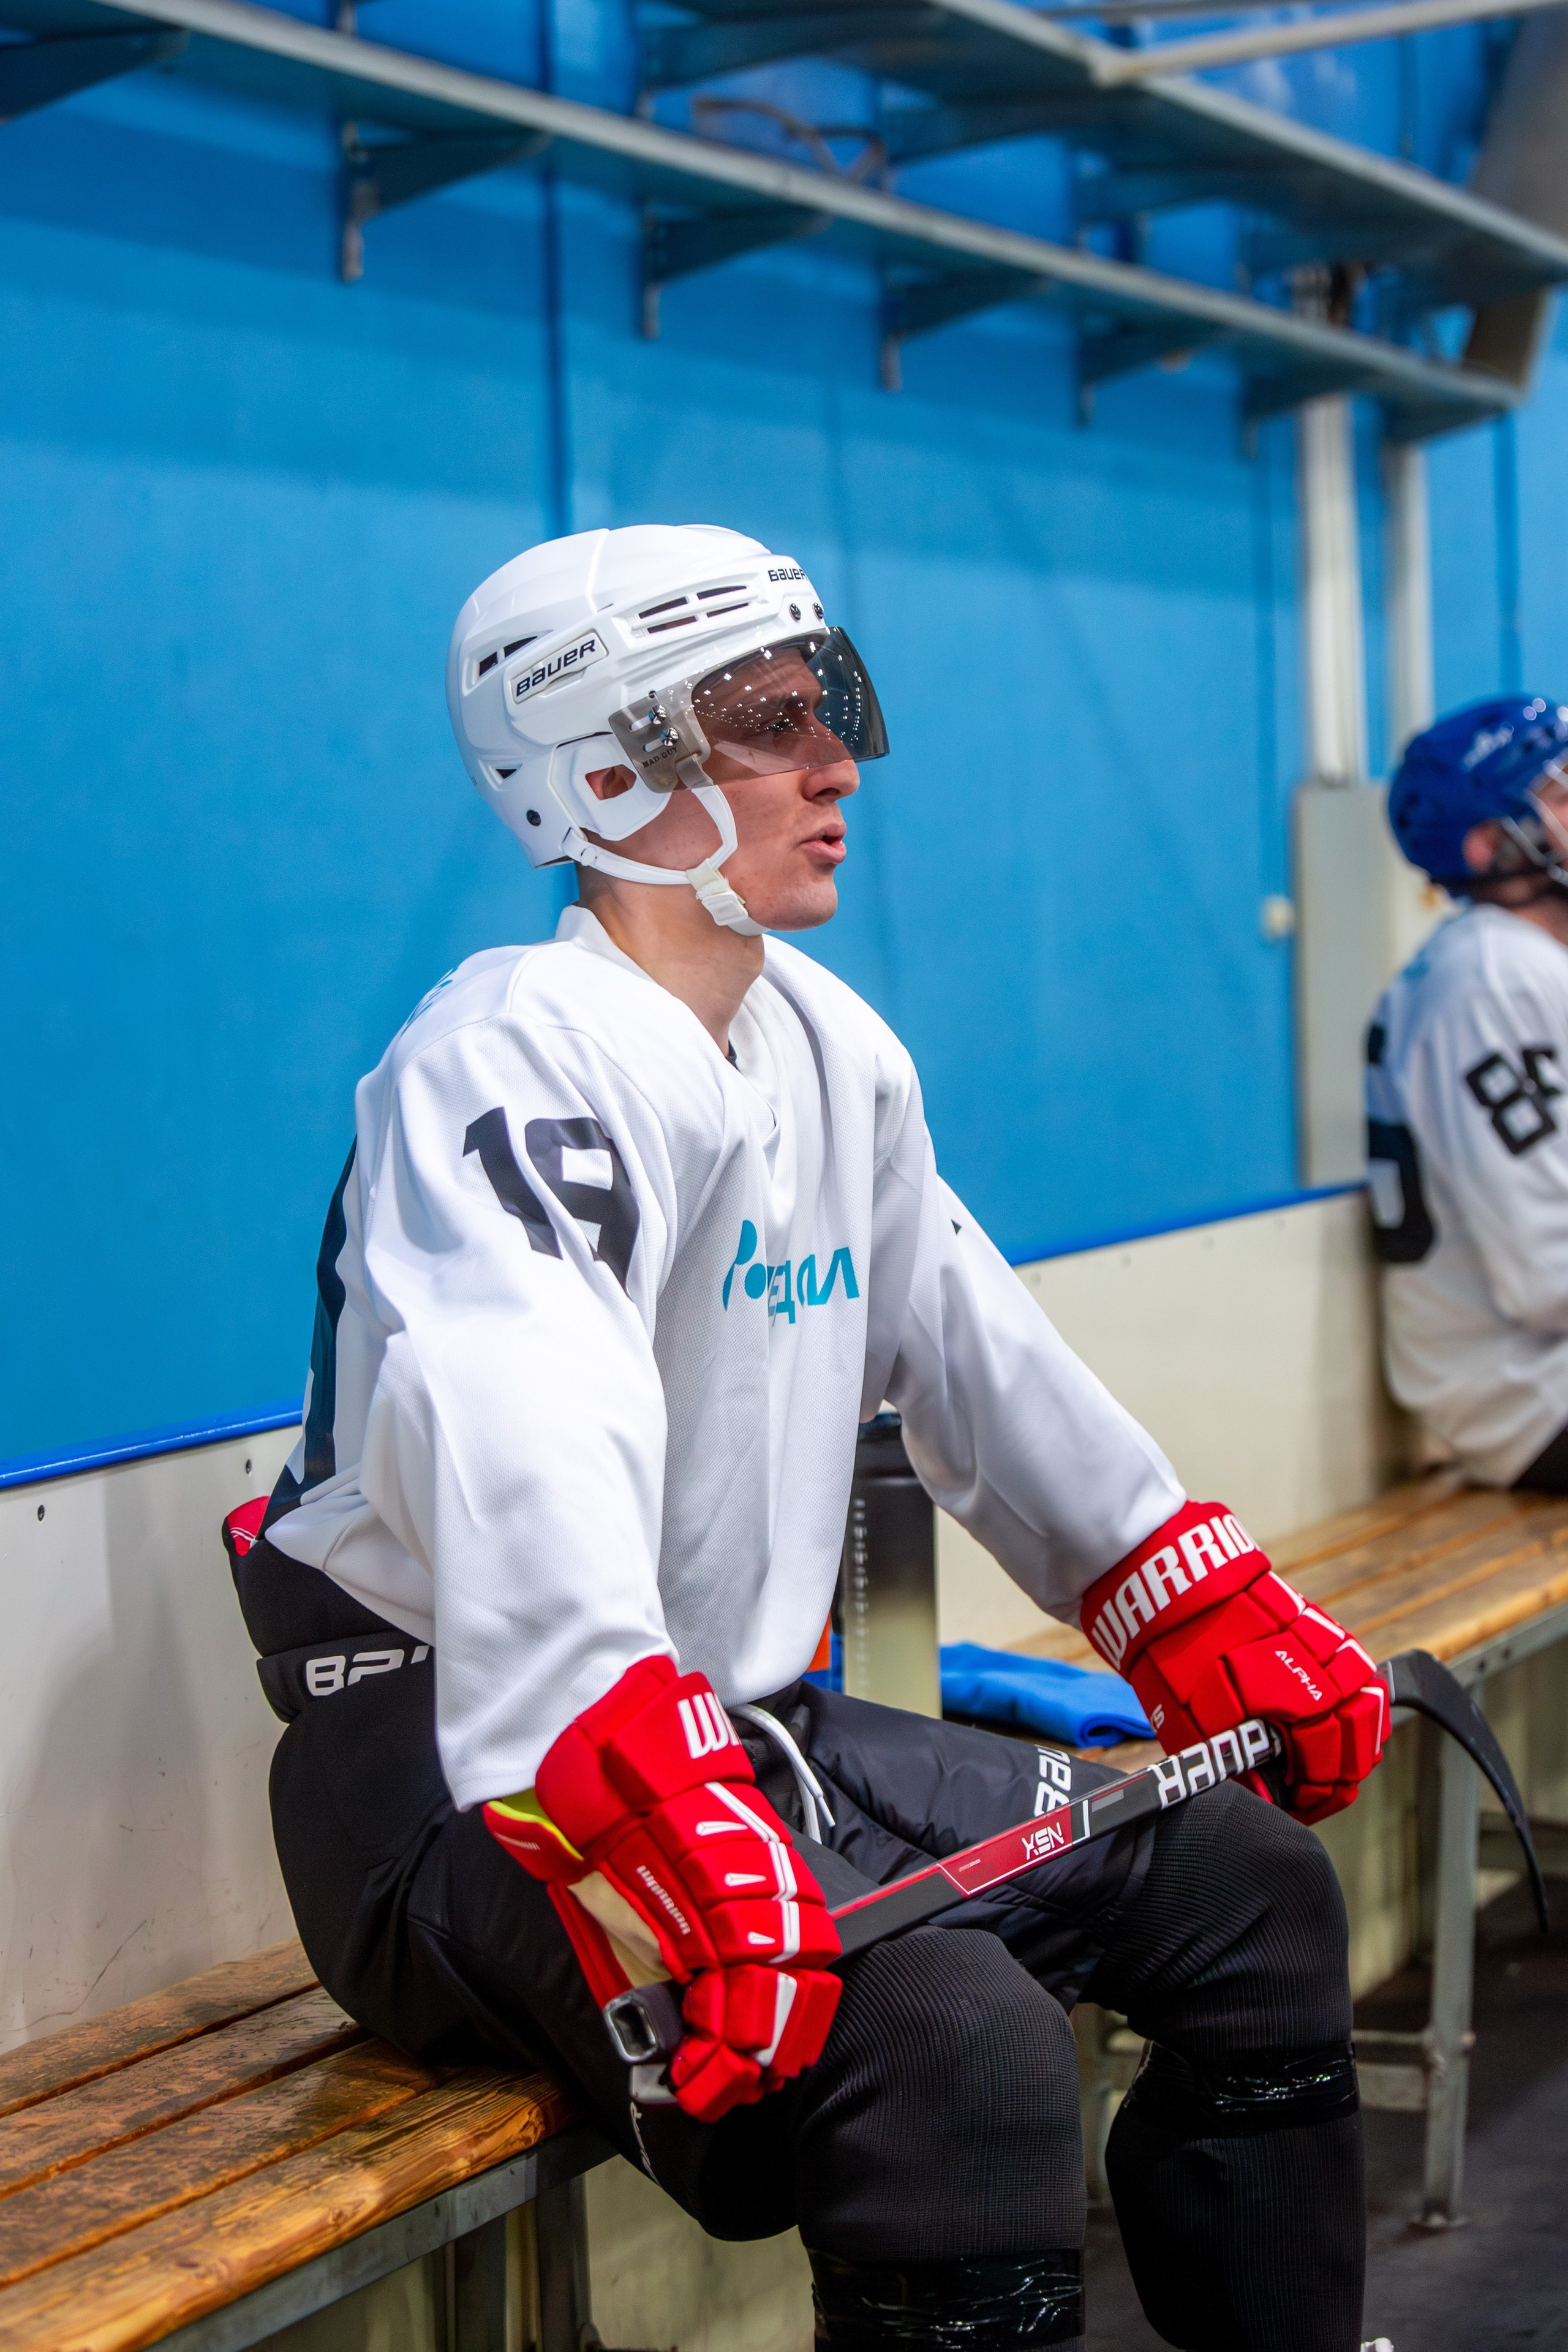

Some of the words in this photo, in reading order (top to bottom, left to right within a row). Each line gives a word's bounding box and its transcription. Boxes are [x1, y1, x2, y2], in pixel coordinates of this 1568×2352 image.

[767, 567, 809, 582] BAUER
[516, 639, 596, 698] BAUER
[642, 756, 660, 769] MAD
[662, 747, 678, 759] GUY
[462, 1106, 641, 1302] 19
[1091, 1513, 1262, 1672] WARRIO
[1275, 1650, 1323, 1702] ALPHA
[1147, 1718, 1282, 1811] AUER
[636, 1864, 692, 1936] WARRIOR
